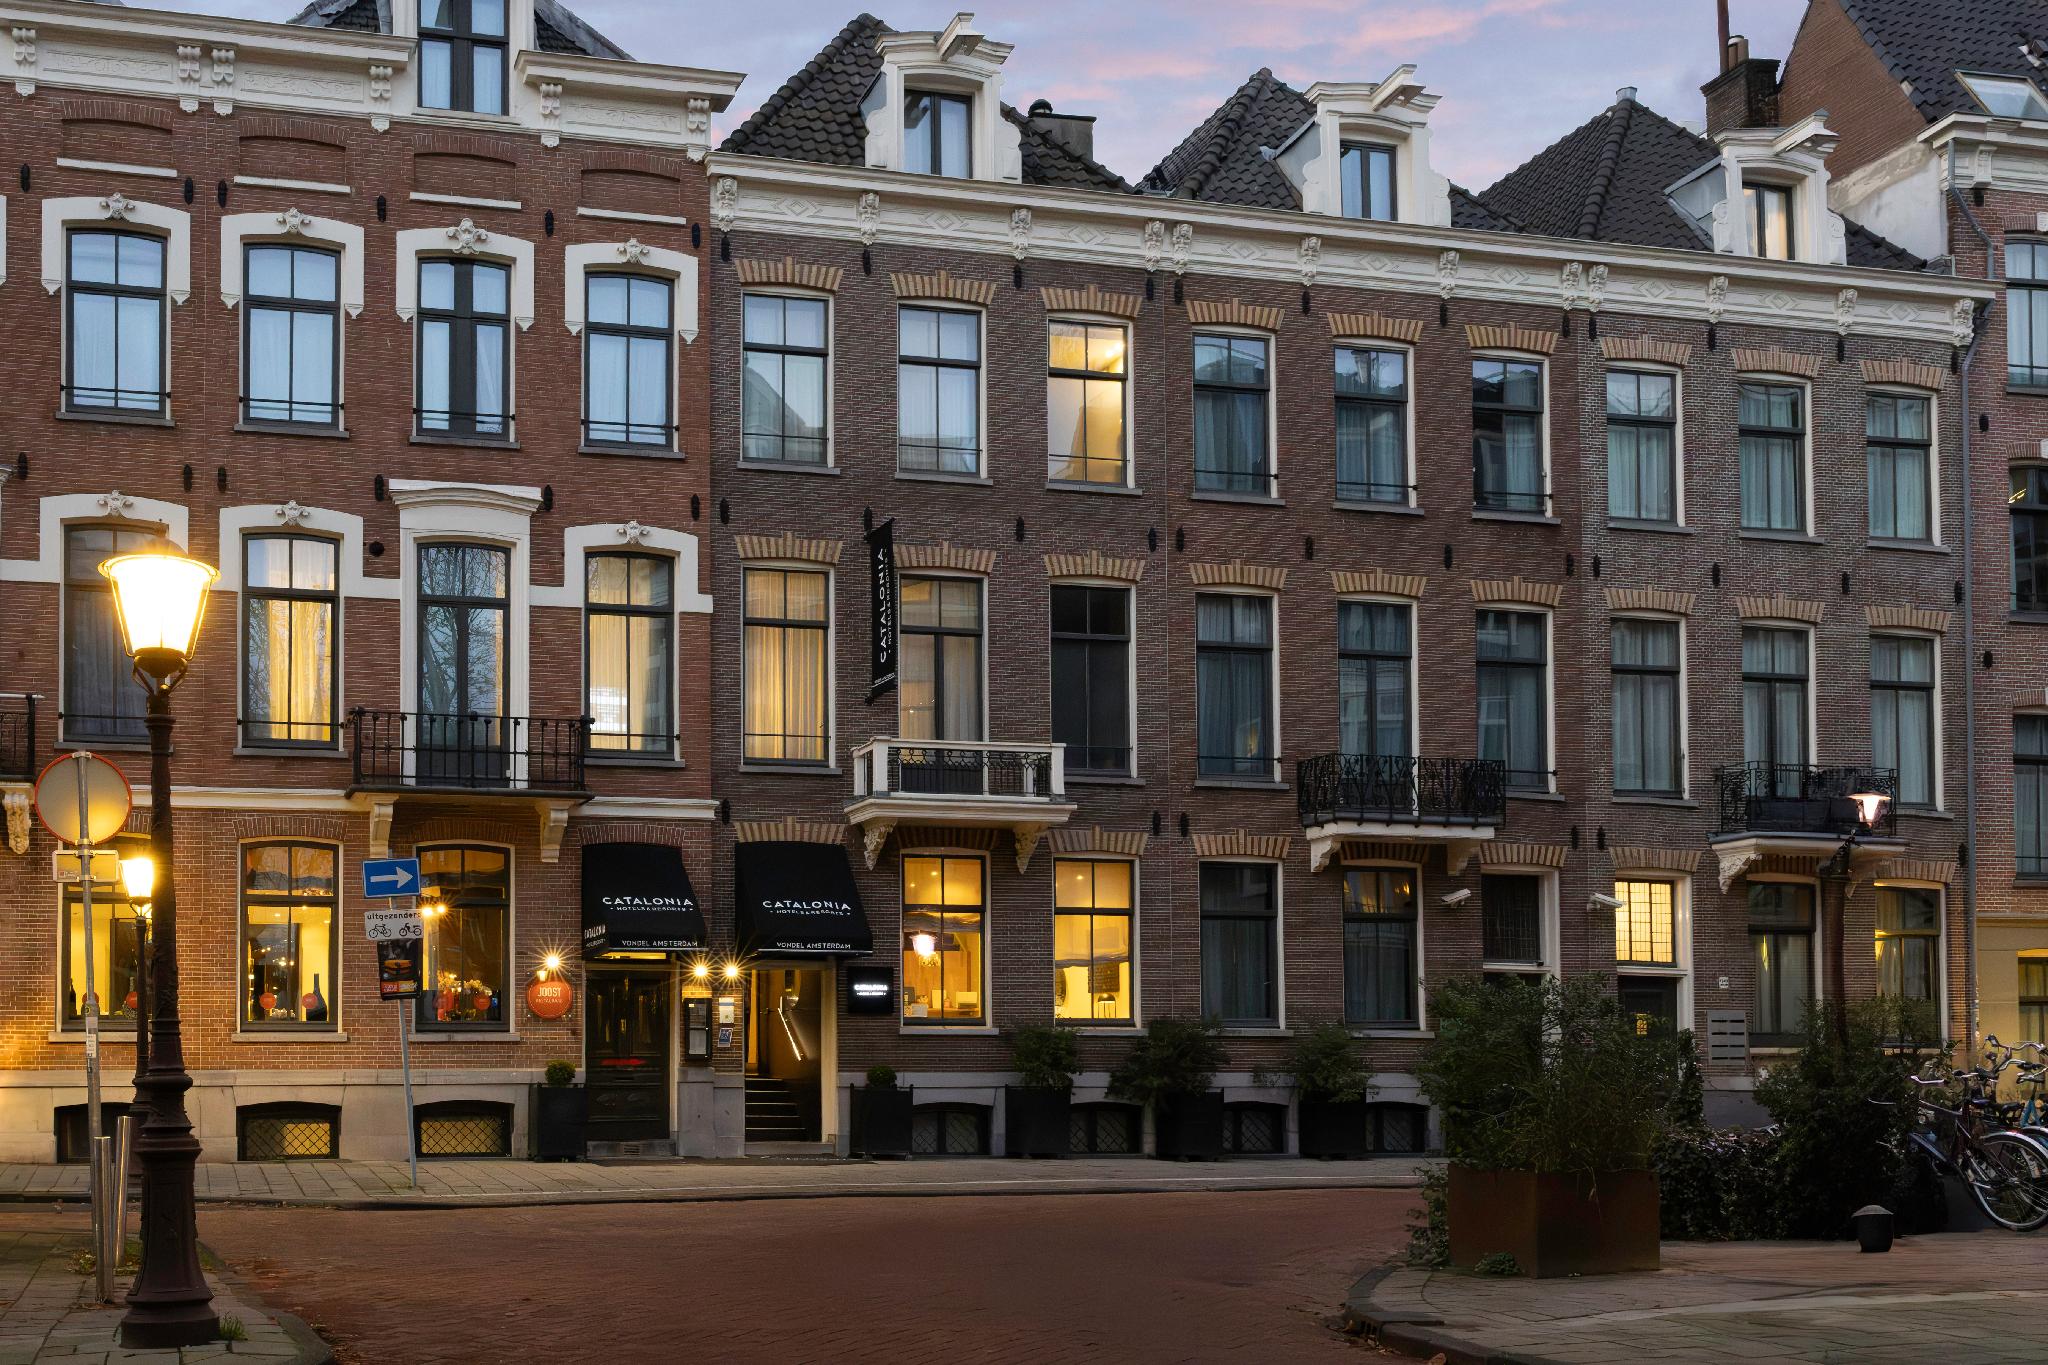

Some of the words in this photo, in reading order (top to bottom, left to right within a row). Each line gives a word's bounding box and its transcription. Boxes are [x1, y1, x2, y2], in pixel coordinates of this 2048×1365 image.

[877, 548, 887, 663] CATALONIA
[602, 896, 694, 906] CATALONIA
[762, 900, 852, 911] CATALONIA
[537, 986, 562, 997] JOOST
